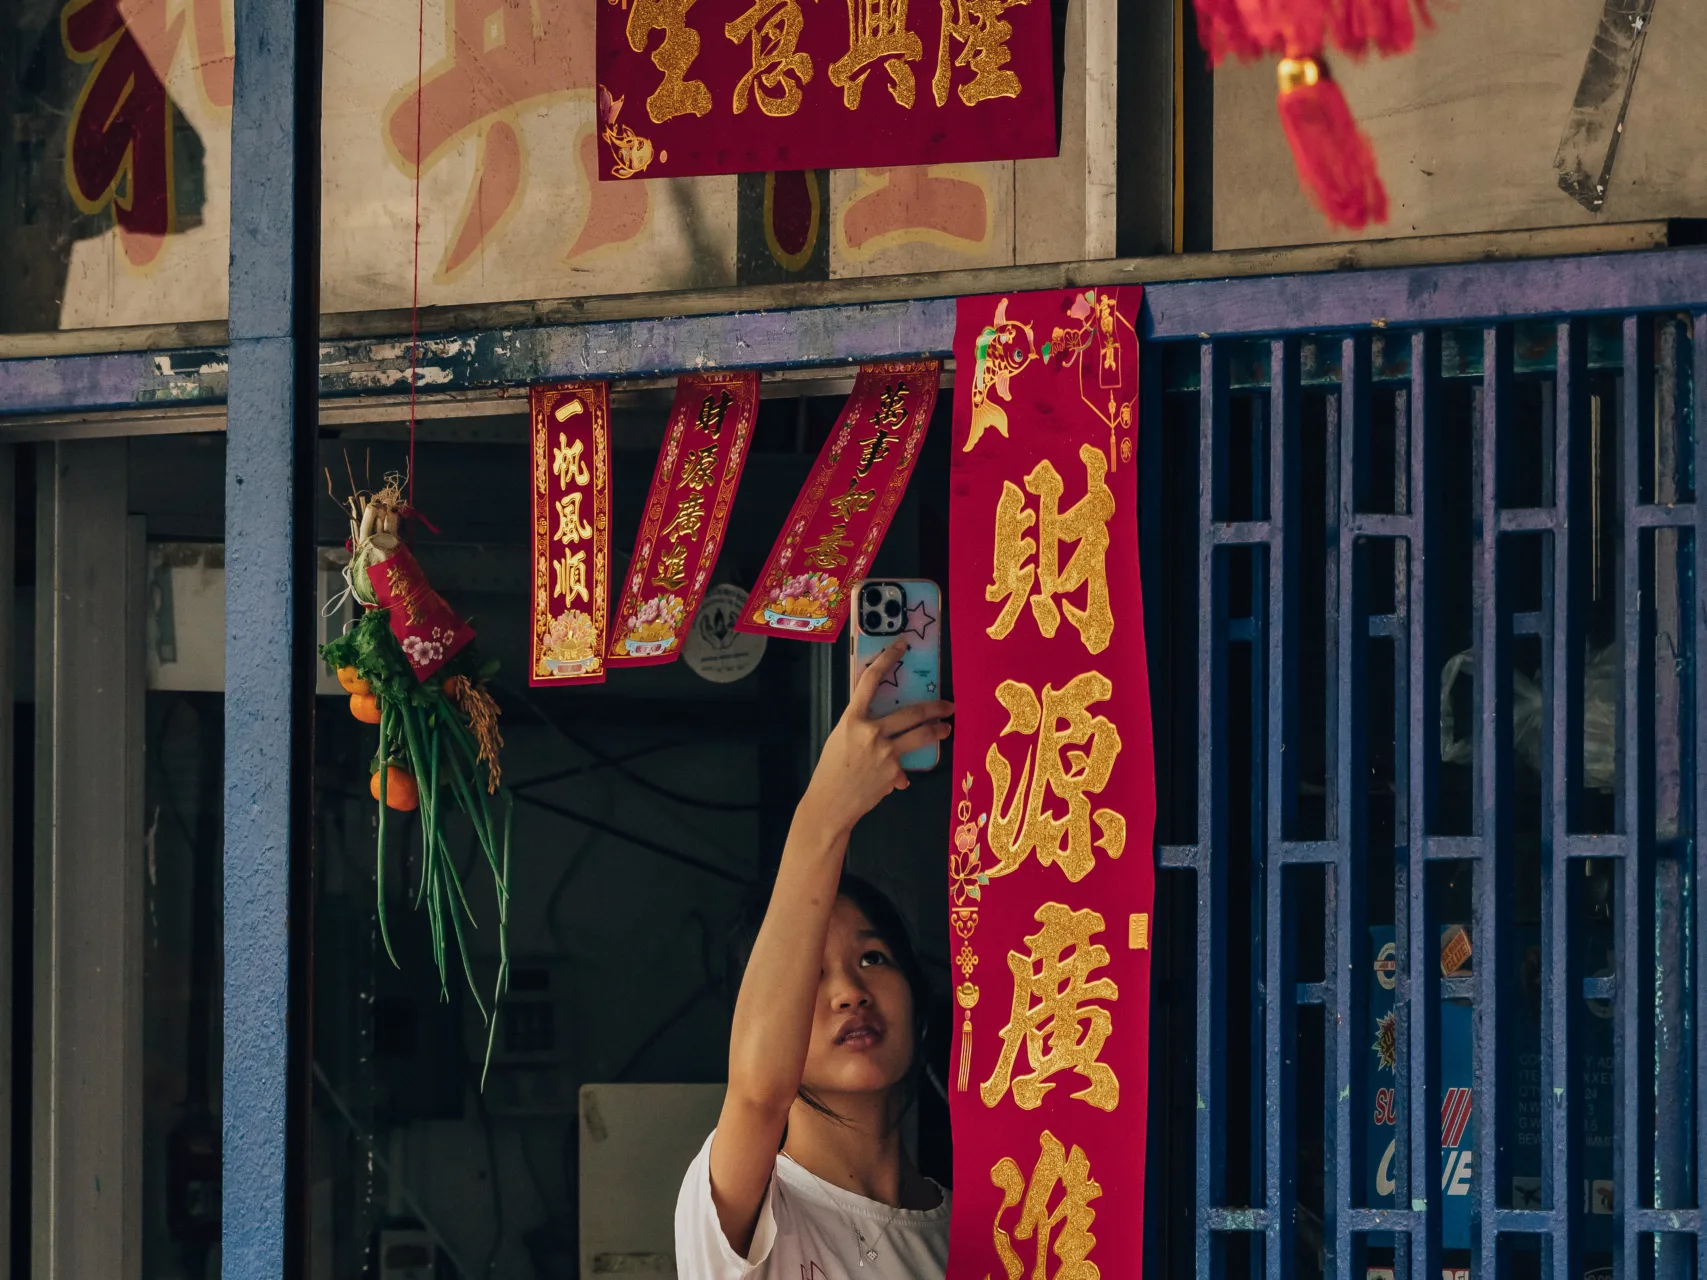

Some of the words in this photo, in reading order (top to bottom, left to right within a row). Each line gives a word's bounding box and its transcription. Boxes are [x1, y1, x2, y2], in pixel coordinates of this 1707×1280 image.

[552, 398, 593, 608] 一帆風順
[651, 389, 733, 591] 財源廣進
[804, 381, 911, 570] 萬事如意
